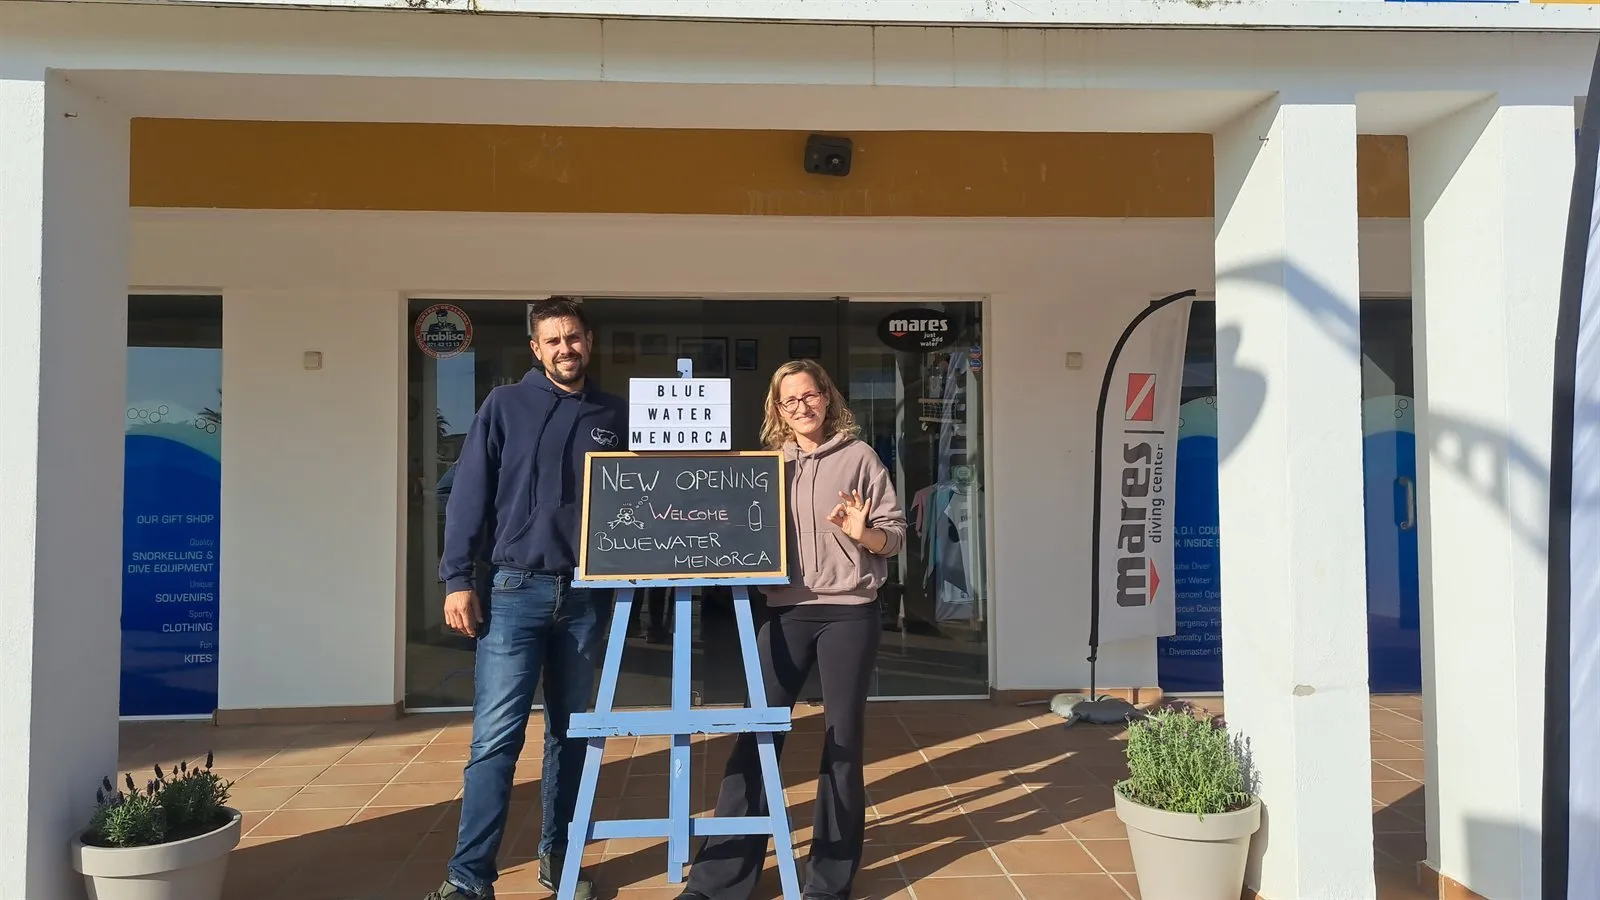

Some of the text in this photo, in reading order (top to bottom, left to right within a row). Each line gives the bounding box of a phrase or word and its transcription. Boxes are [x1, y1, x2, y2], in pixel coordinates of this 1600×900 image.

[889, 319, 948, 331] mares
[422, 332, 464, 341] Trablisa
[657, 385, 705, 397] BLUE
[648, 408, 712, 420] WATER
[632, 431, 727, 443] MENORCA
[602, 462, 768, 493] NEW OPENING
[1149, 443, 1165, 543] diving center
[648, 502, 729, 521] WELCOME
[137, 514, 214, 524] OUR GIFT SHOP
[1116, 442, 1152, 607] mares
[189, 538, 214, 547] Quality
[595, 531, 722, 551] BLUEWATER
[1183, 538, 1214, 548] INSIDE
[132, 550, 214, 561] SNORKELLING &
[674, 550, 772, 569] MENORCA
[127, 563, 214, 573] DIVE EQUIPMENT
[1191, 561, 1211, 570] Diver
[189, 580, 214, 590] Unique
[1188, 576, 1211, 585] Water
[155, 593, 214, 602] SOUVENIRS
[189, 610, 213, 619] Sporty
[162, 622, 213, 633] CLOTHING
[200, 641, 213, 649] Fun
[1169, 647, 1211, 656] Divemaster
[184, 653, 213, 663] KITES
